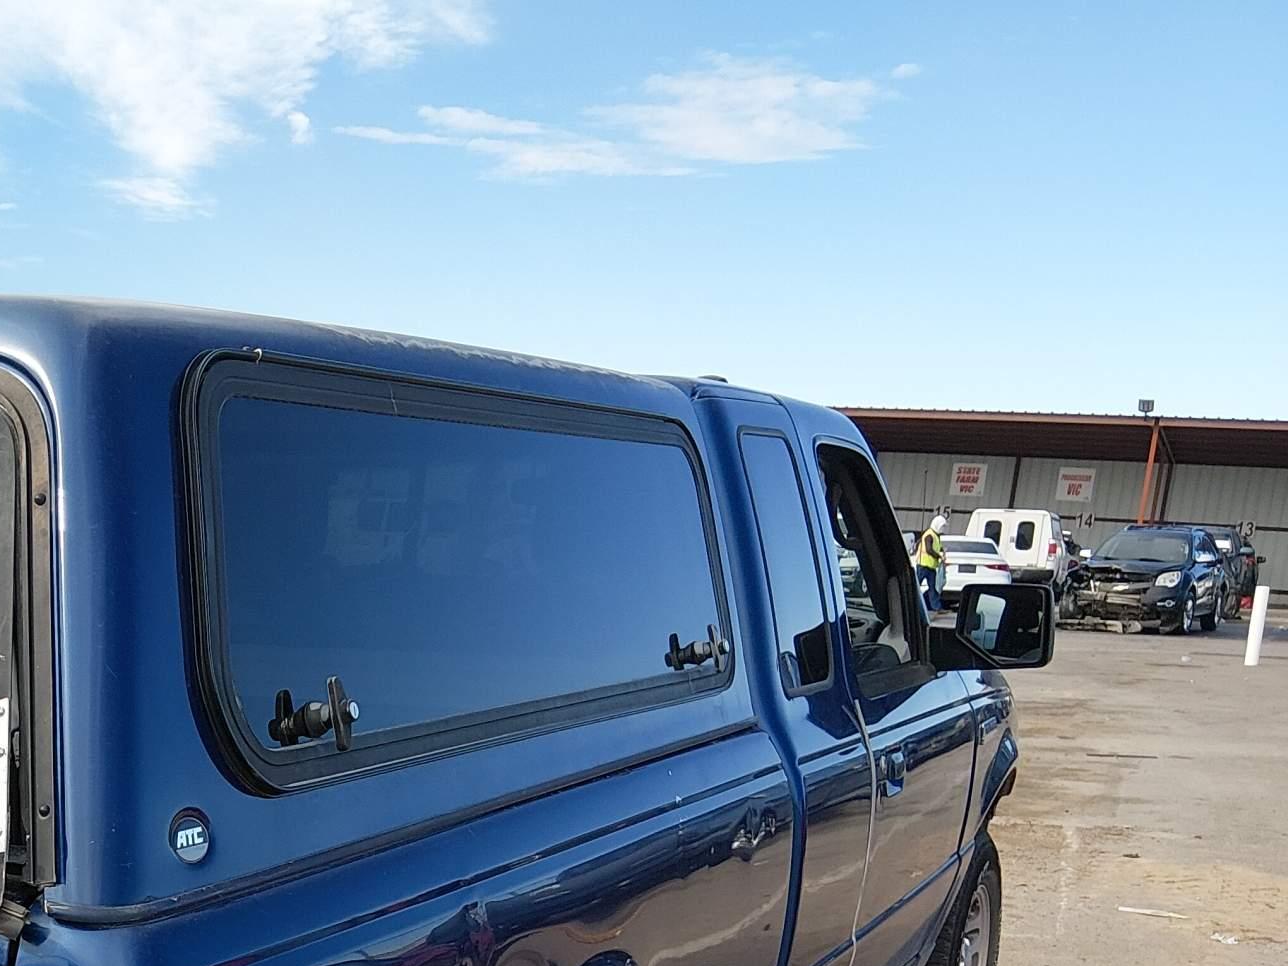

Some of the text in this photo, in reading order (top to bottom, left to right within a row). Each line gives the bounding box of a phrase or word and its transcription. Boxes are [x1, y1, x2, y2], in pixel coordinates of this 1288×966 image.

[956, 466, 982, 475] STATE
[1067, 483, 1082, 496] VIC
[935, 505, 950, 521] 15
[1077, 513, 1093, 528] 14
[1238, 521, 1254, 537] 13
[176, 826, 204, 849] ATC
